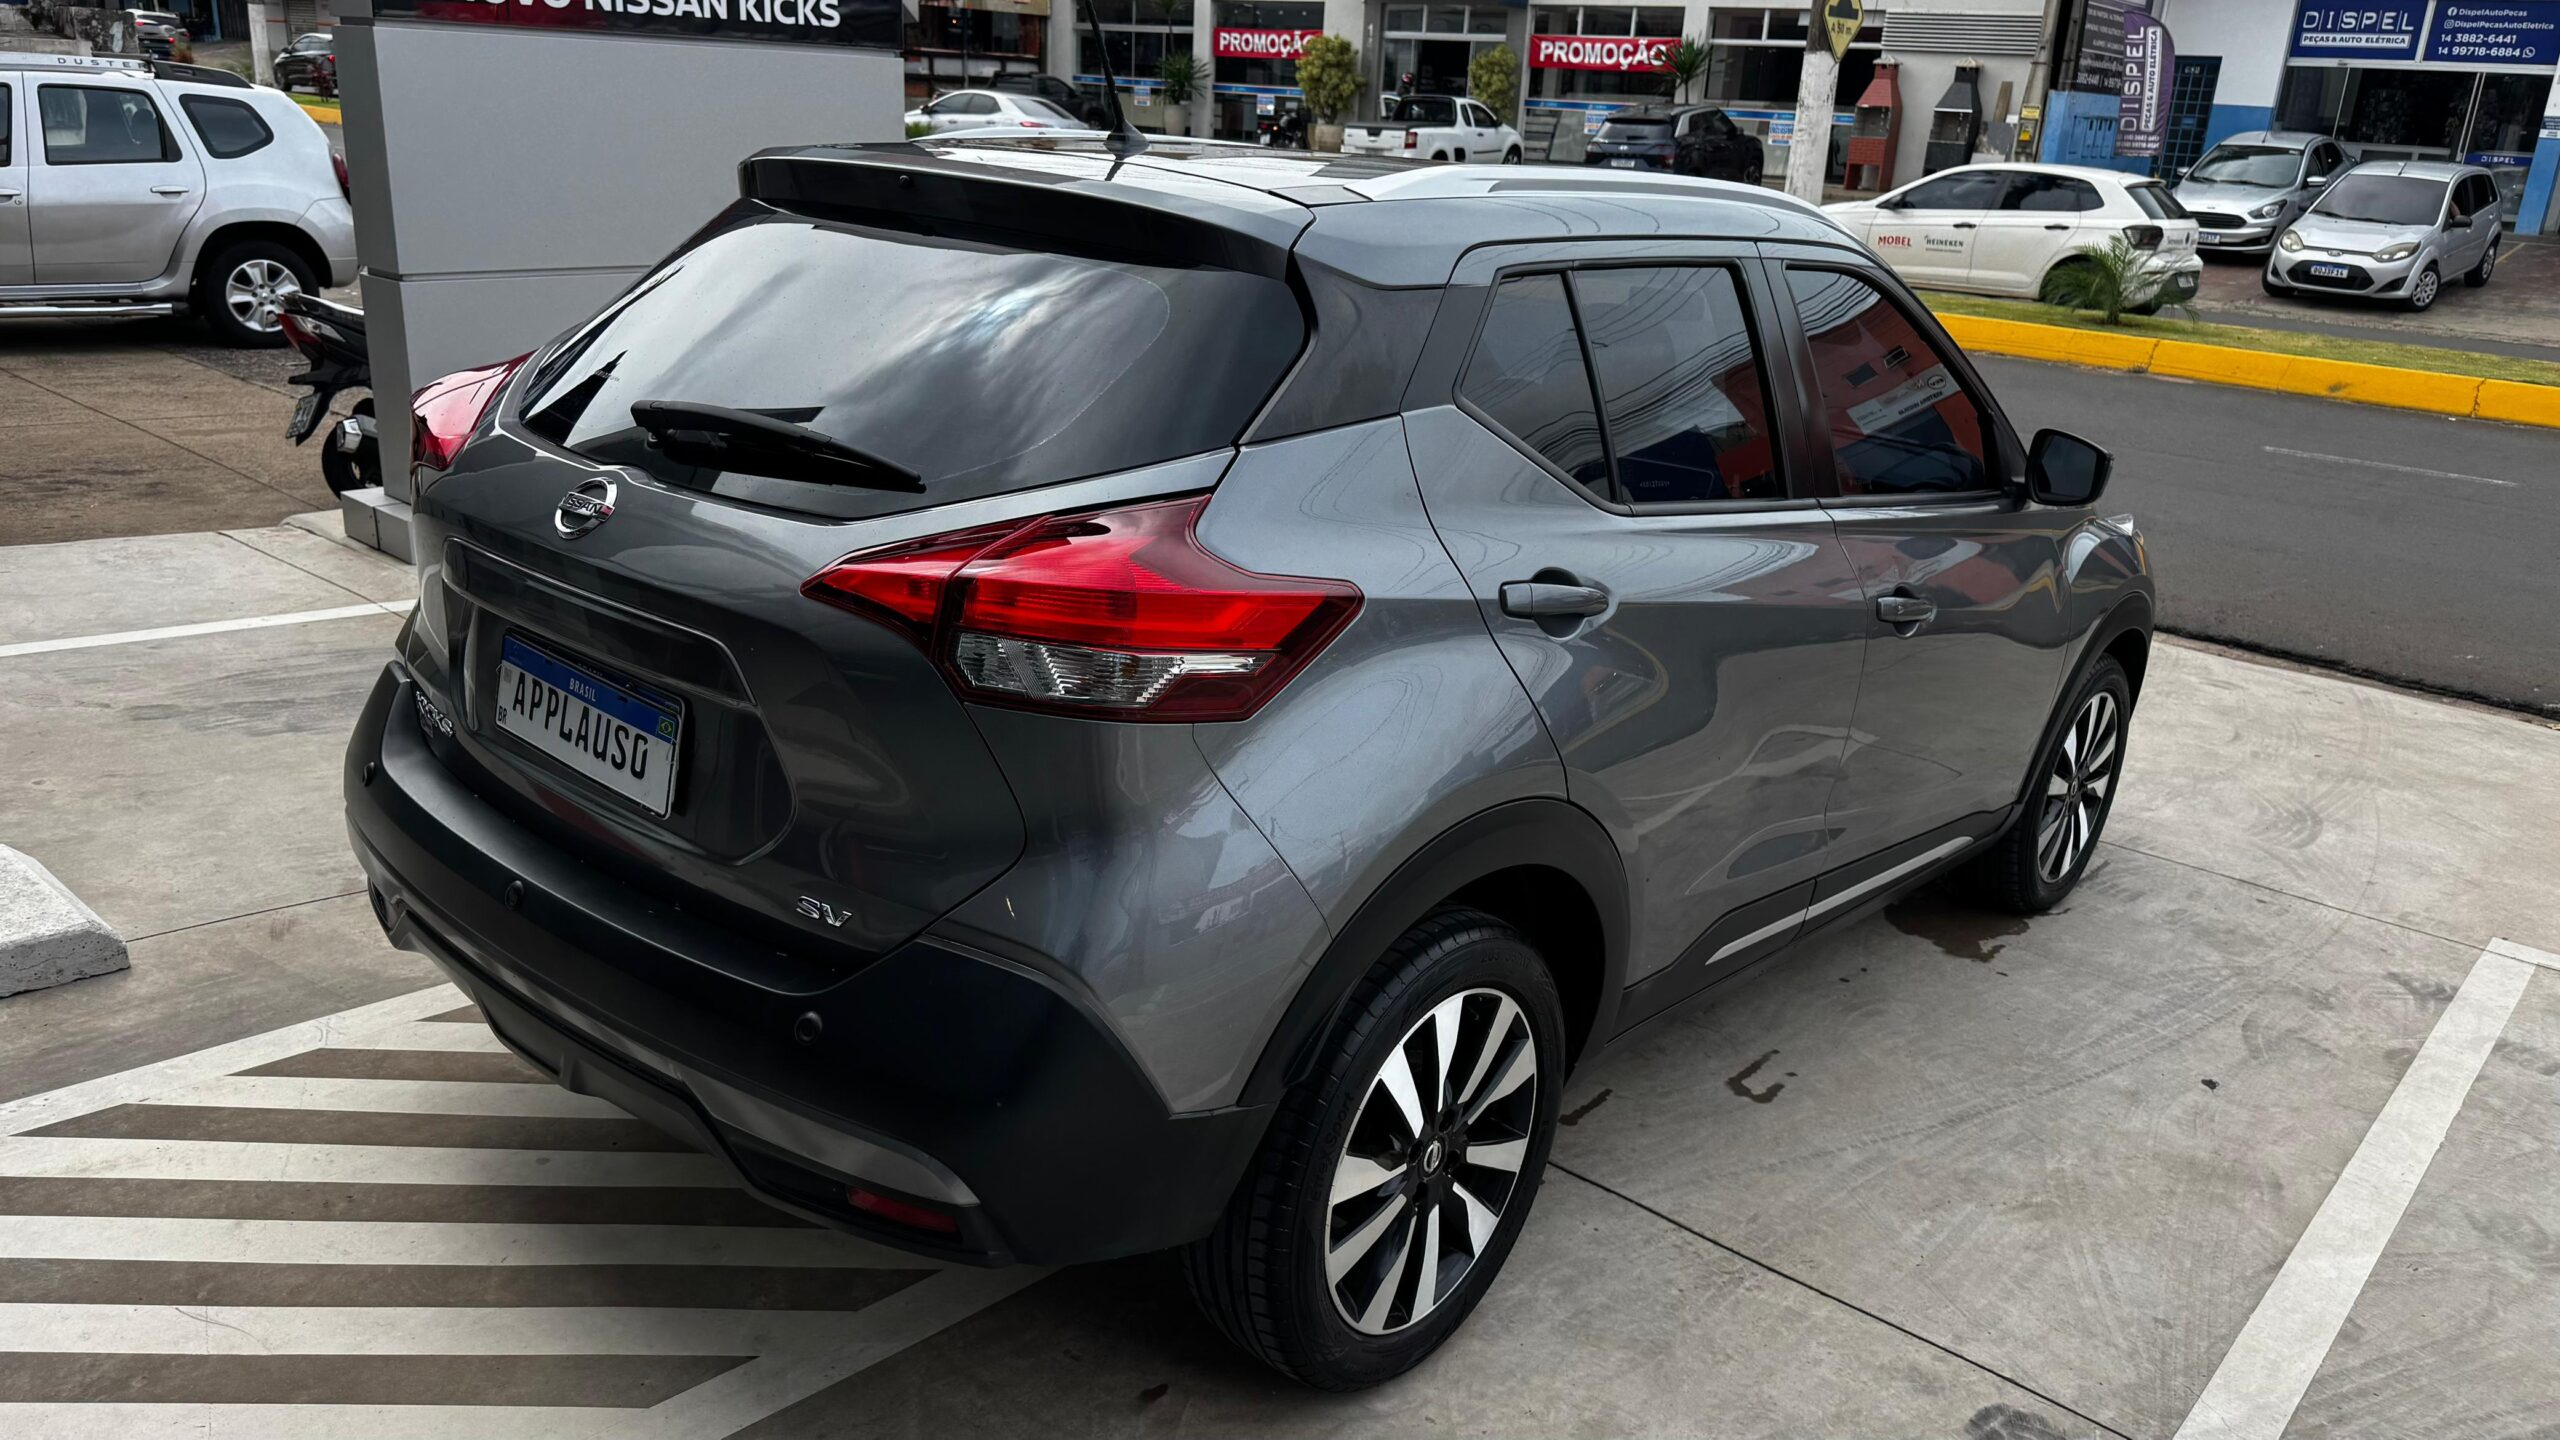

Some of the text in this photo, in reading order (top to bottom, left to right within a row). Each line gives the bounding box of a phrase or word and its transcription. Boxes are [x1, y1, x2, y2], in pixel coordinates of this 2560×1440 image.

[738, 0, 840, 28] KICKS
[2302, 10, 2414, 31] DISPEL
[2458, 8, 2528, 17] DispelAutoPecas
[2454, 20, 2555, 30] DispelPecasAutoEletrica
[2303, 35, 2330, 43] PEÇAS
[2338, 36, 2362, 44] AUTO
[2365, 35, 2406, 45] ELÉTRICA
[2441, 33, 2517, 44] 14 3882-6441
[1539, 38, 1667, 70] PROMOÇÃO
[2438, 46, 2521, 57] 14 99718-6884
[57, 57, 149, 71] DUSTER
[2120, 26, 2144, 131] DISPEL
[2147, 70, 2157, 93] AUTO
[2480, 155, 2515, 164] DISPEL
[1877, 235, 1912, 247] MOBEL
[1926, 238, 1964, 248] HEINEKEN
[569, 677, 597, 702] BRASIL
[497, 705, 508, 725] BR
[512, 671, 649, 780] APPLAUSO
[796, 896, 852, 927] SV
